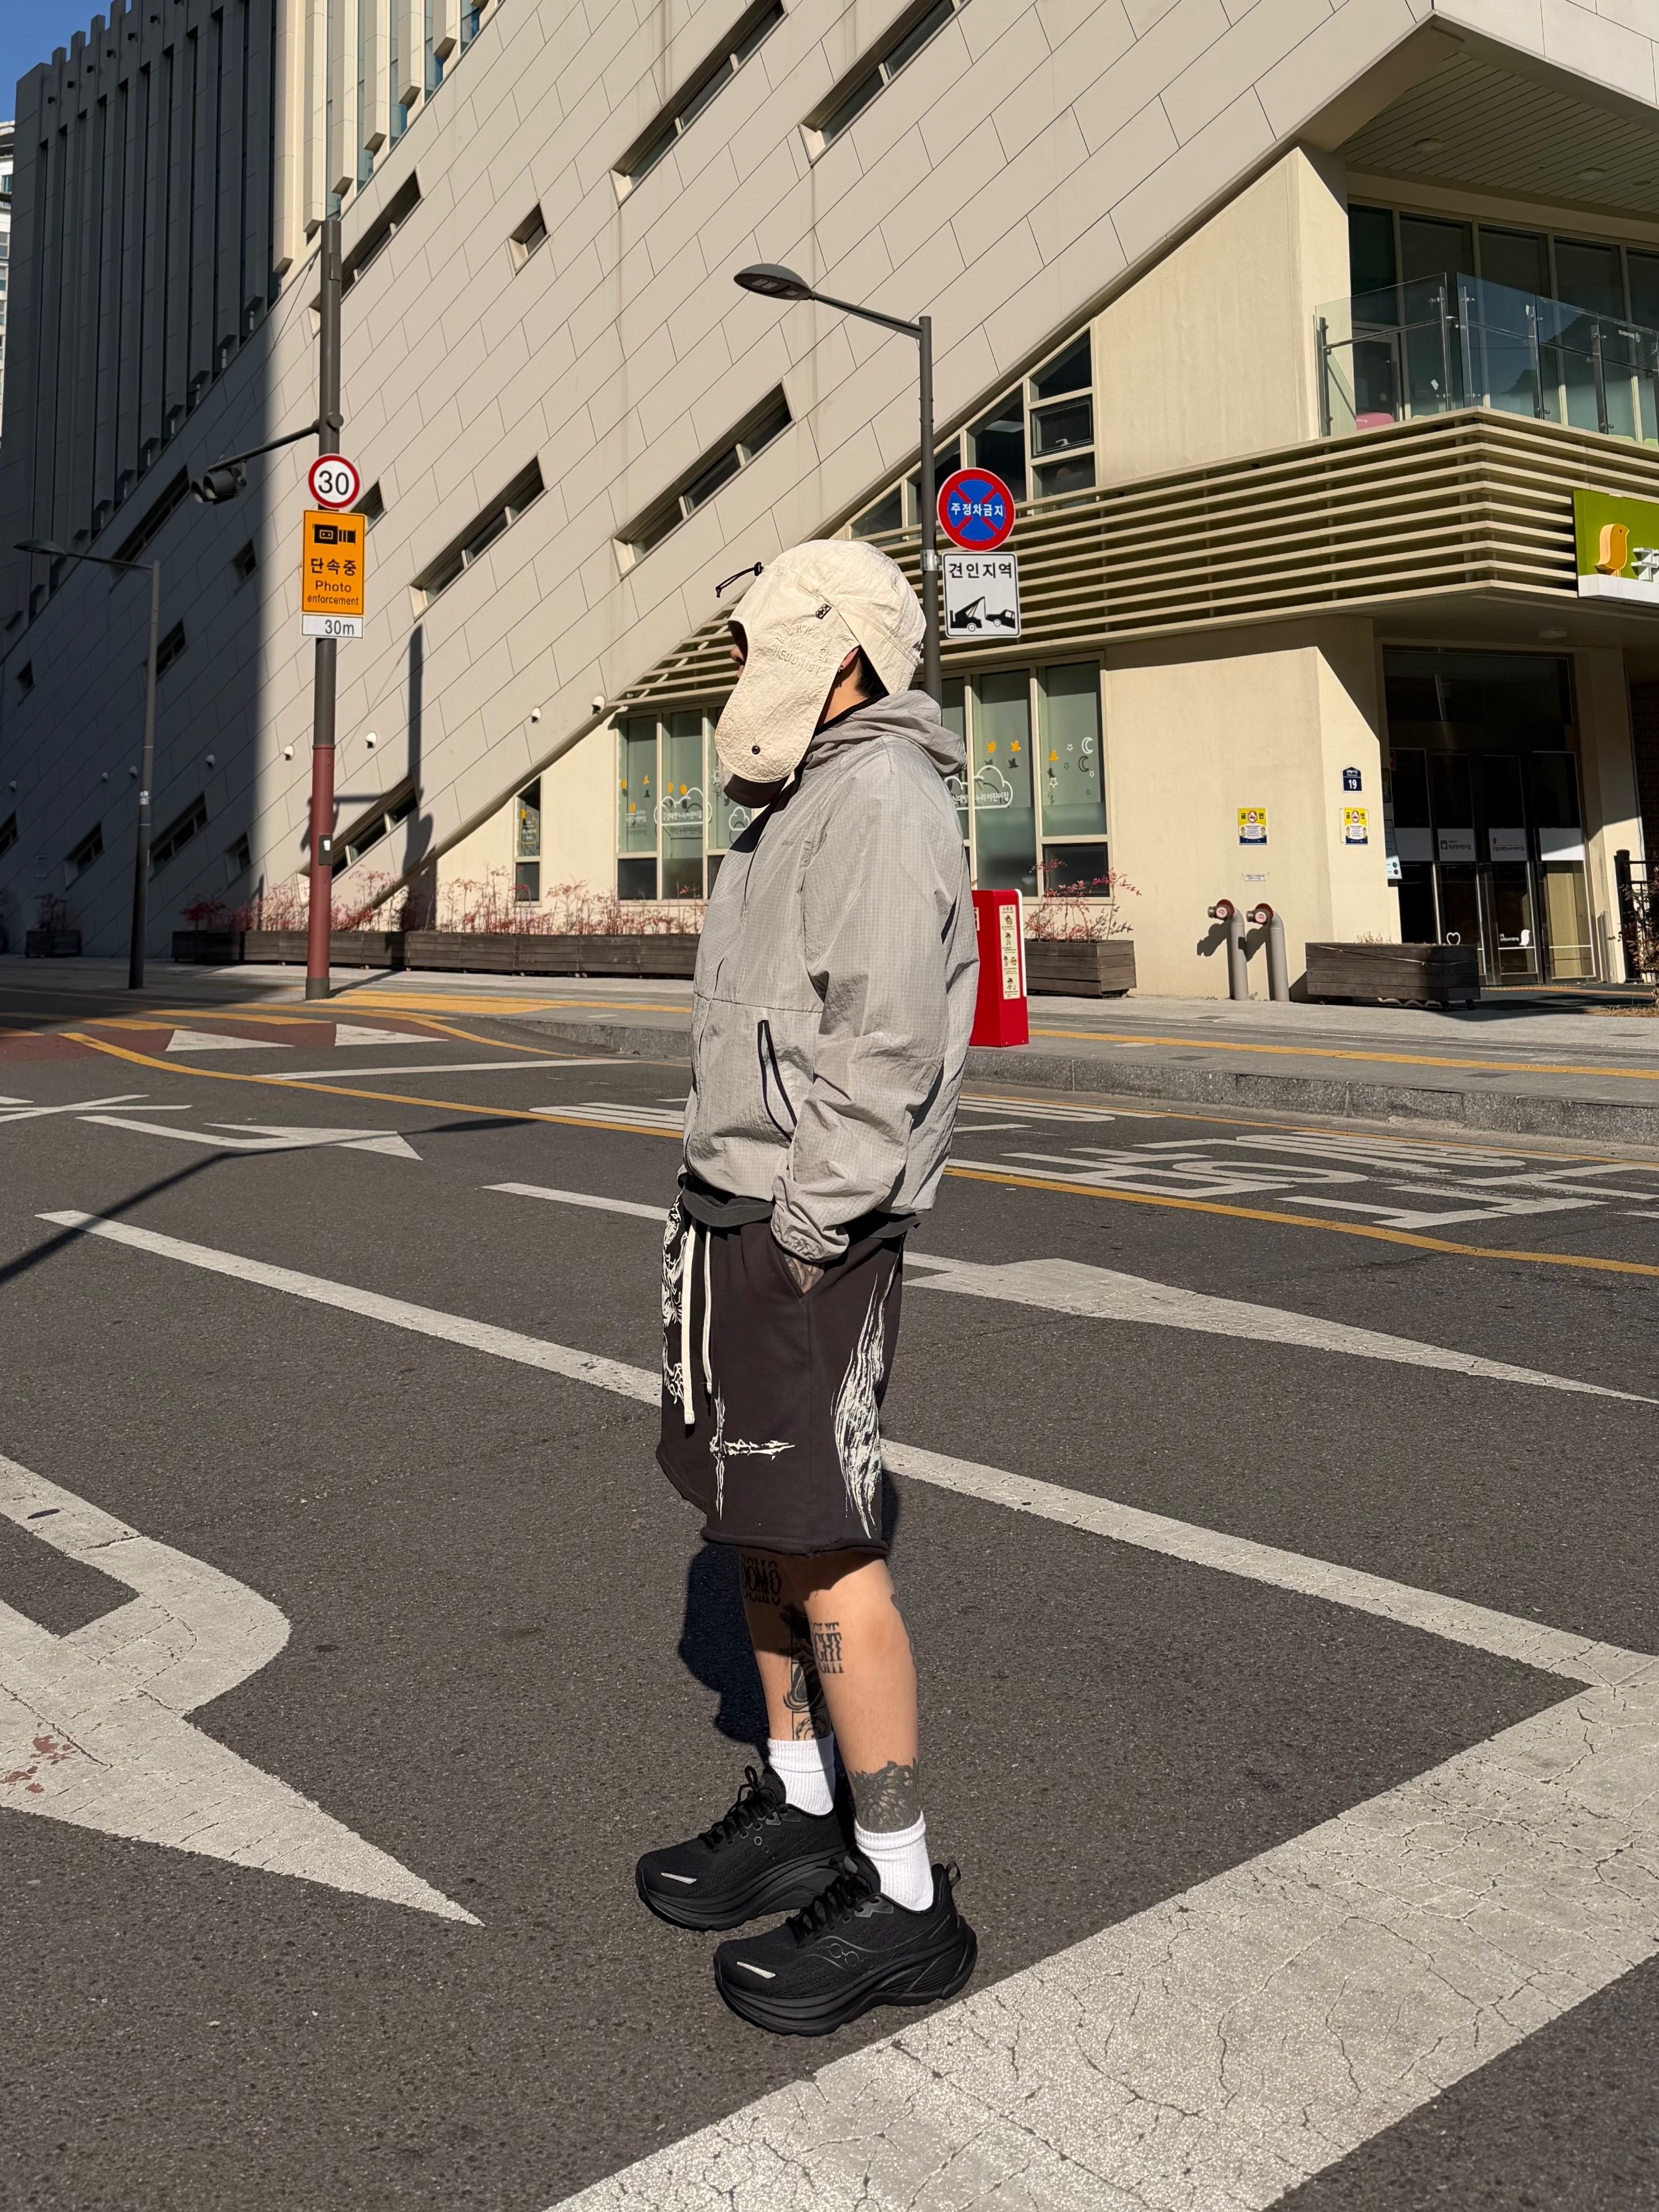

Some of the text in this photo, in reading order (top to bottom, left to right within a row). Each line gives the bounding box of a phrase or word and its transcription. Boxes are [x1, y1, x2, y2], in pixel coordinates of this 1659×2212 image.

[318, 470, 349, 496] 30
[950, 503, 1004, 517] 주정차금지
[311, 558, 356, 576] 단속중
[948, 562, 1013, 579] 견인지역
[315, 581, 352, 593] Photo
[307, 594, 359, 606] enforcement
[325, 619, 355, 636] 30m
[1348, 779, 1357, 789] 19
